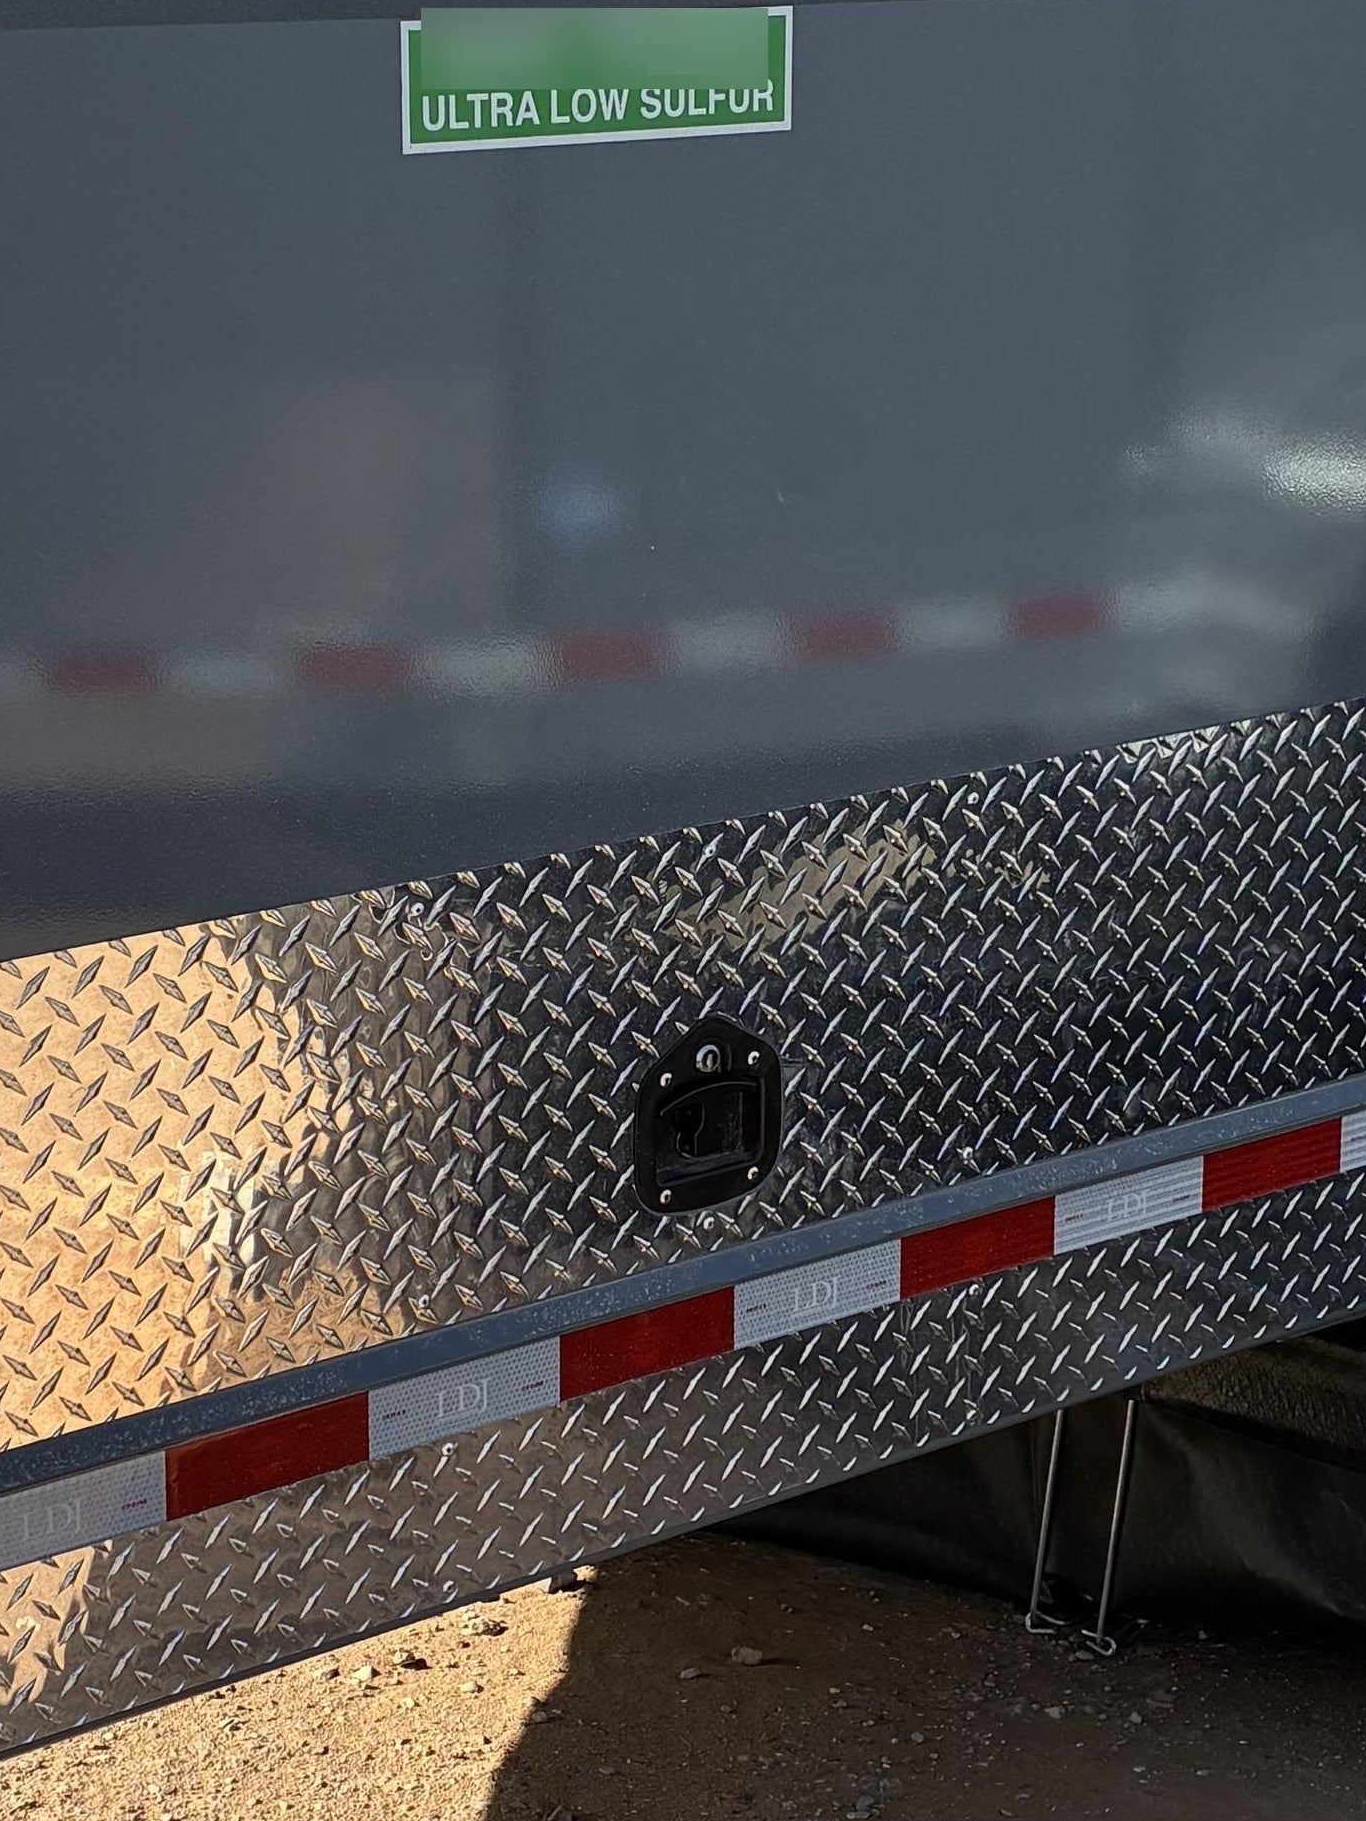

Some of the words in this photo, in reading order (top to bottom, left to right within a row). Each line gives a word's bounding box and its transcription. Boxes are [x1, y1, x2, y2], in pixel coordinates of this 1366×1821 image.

[421, 91, 540, 132] ULTRA
[549, 87, 630, 125] LOW
[639, 79, 775, 120] SULFUR
[435, 1377, 493, 1418] LDJ
